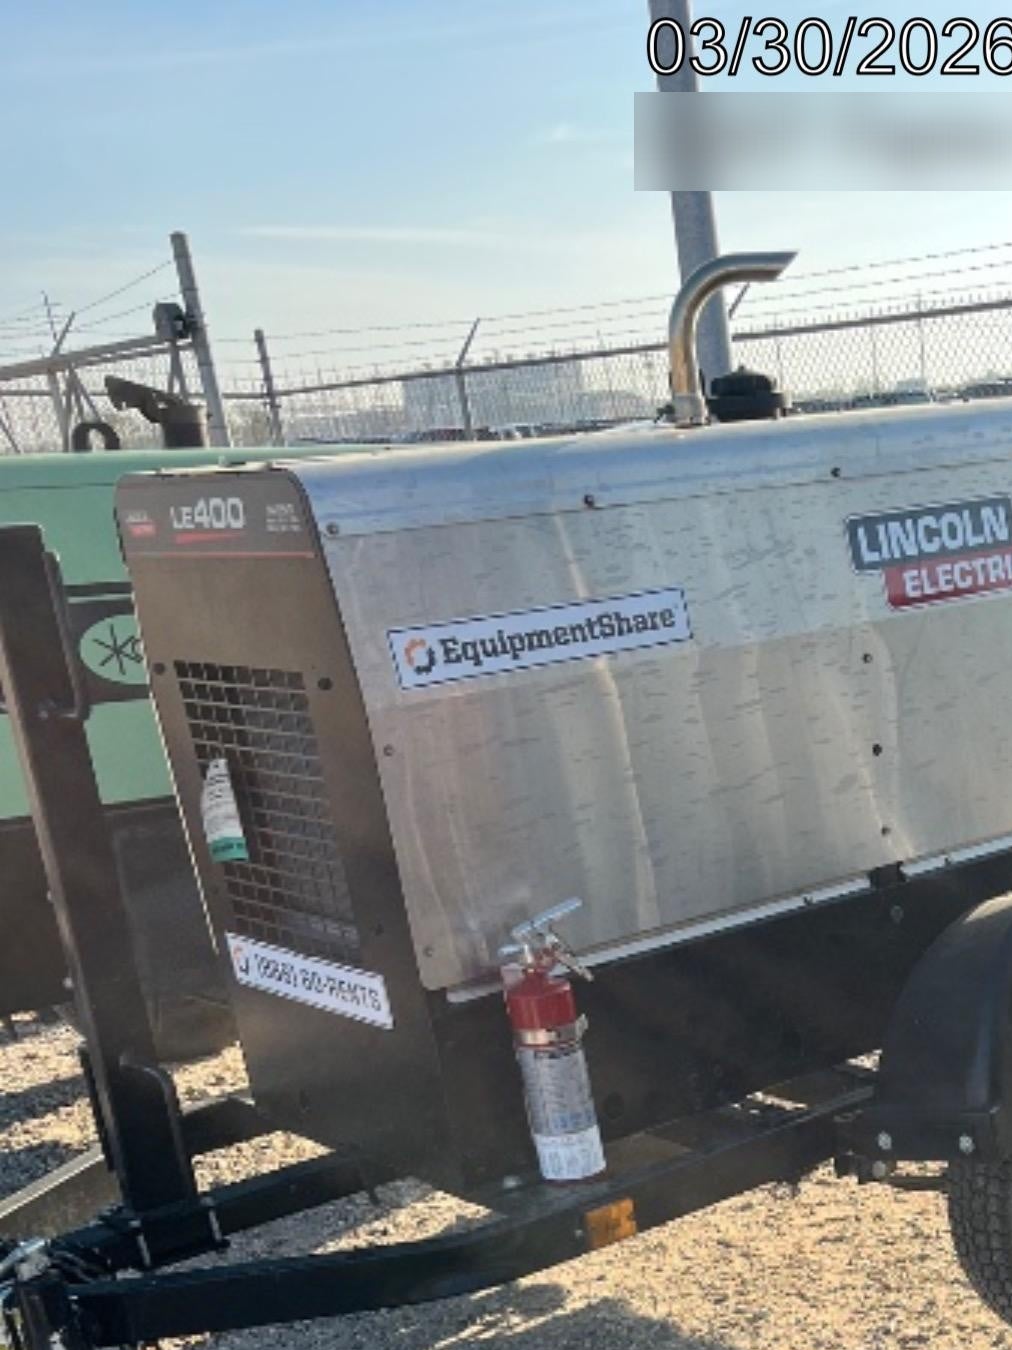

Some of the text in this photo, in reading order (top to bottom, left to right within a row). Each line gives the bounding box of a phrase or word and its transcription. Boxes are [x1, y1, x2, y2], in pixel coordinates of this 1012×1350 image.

[170, 497, 245, 529] LE400
[857, 506, 1009, 563] LINCOLN
[438, 606, 677, 666] EquipmentShare
